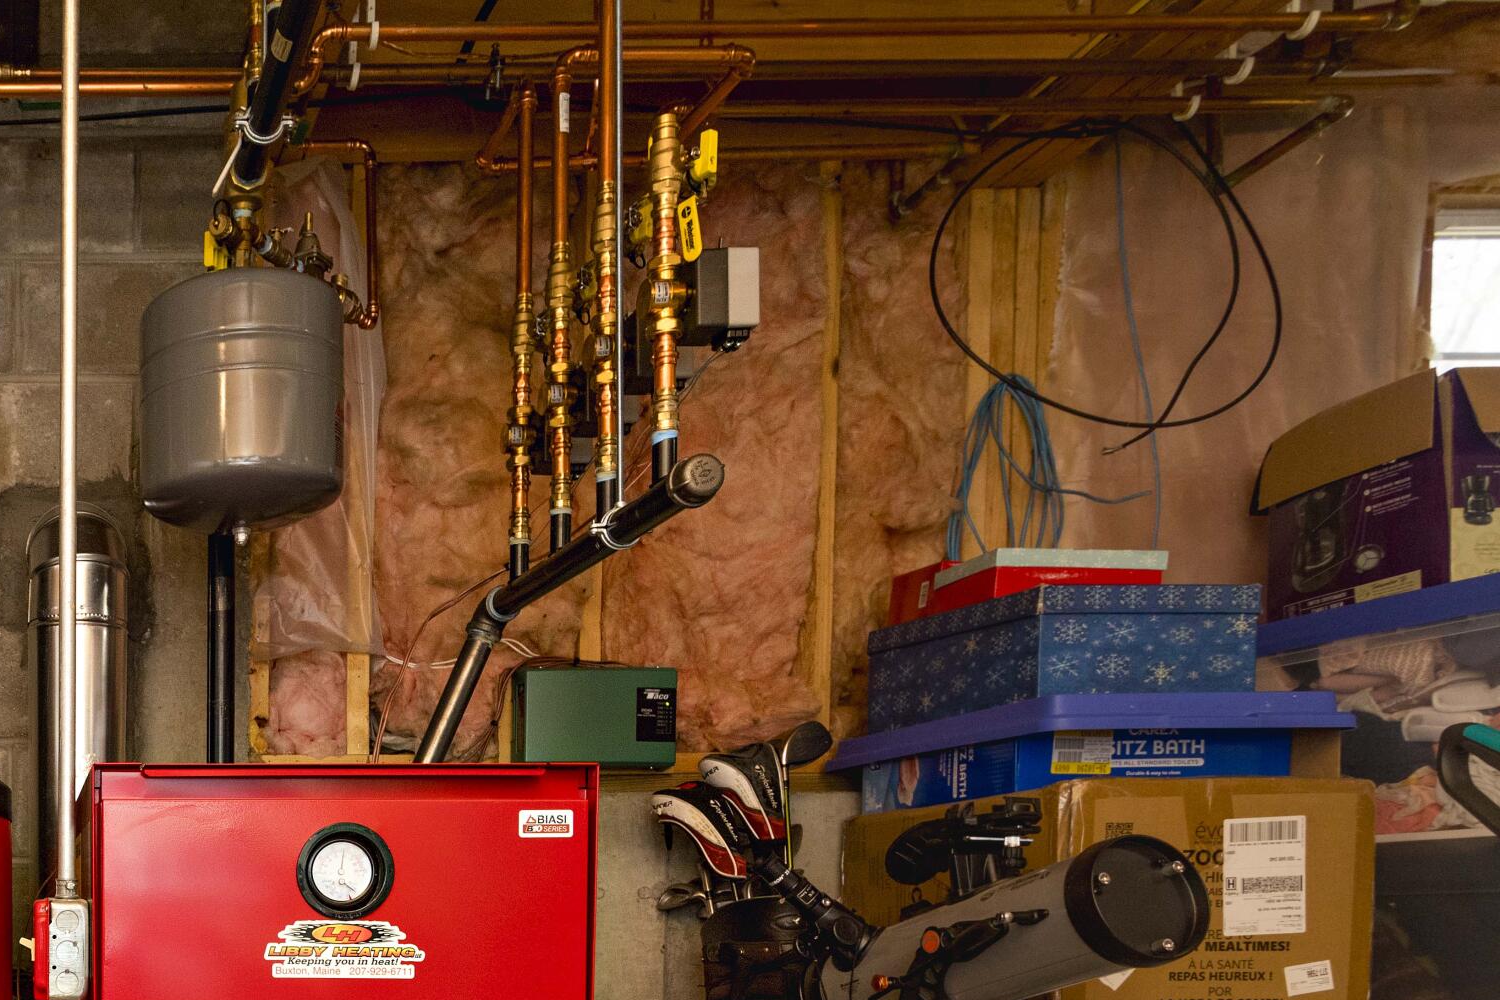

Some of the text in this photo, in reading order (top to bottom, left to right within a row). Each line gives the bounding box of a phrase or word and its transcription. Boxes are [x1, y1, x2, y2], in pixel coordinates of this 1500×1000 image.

[644, 689, 669, 700] Taco
[1153, 739, 1205, 756] BATH
[959, 763, 968, 798] BATH
[537, 814, 567, 824] BIASI
[1205, 941, 1290, 951] MEALTIMES!
[267, 945, 328, 957] LIBBY
[331, 946, 415, 958] HEATING
[287, 957, 333, 967] Keeping
[335, 959, 355, 967] you
[370, 957, 399, 966] heat!
[1189, 958, 1254, 969] À LA SANTÉ
[275, 967, 412, 976] Buxton, Maine 207-929-6711
[1168, 972, 1205, 981] REPAS
[1208, 971, 1266, 981] HEUREUX
[1208, 987, 1231, 996] POR
